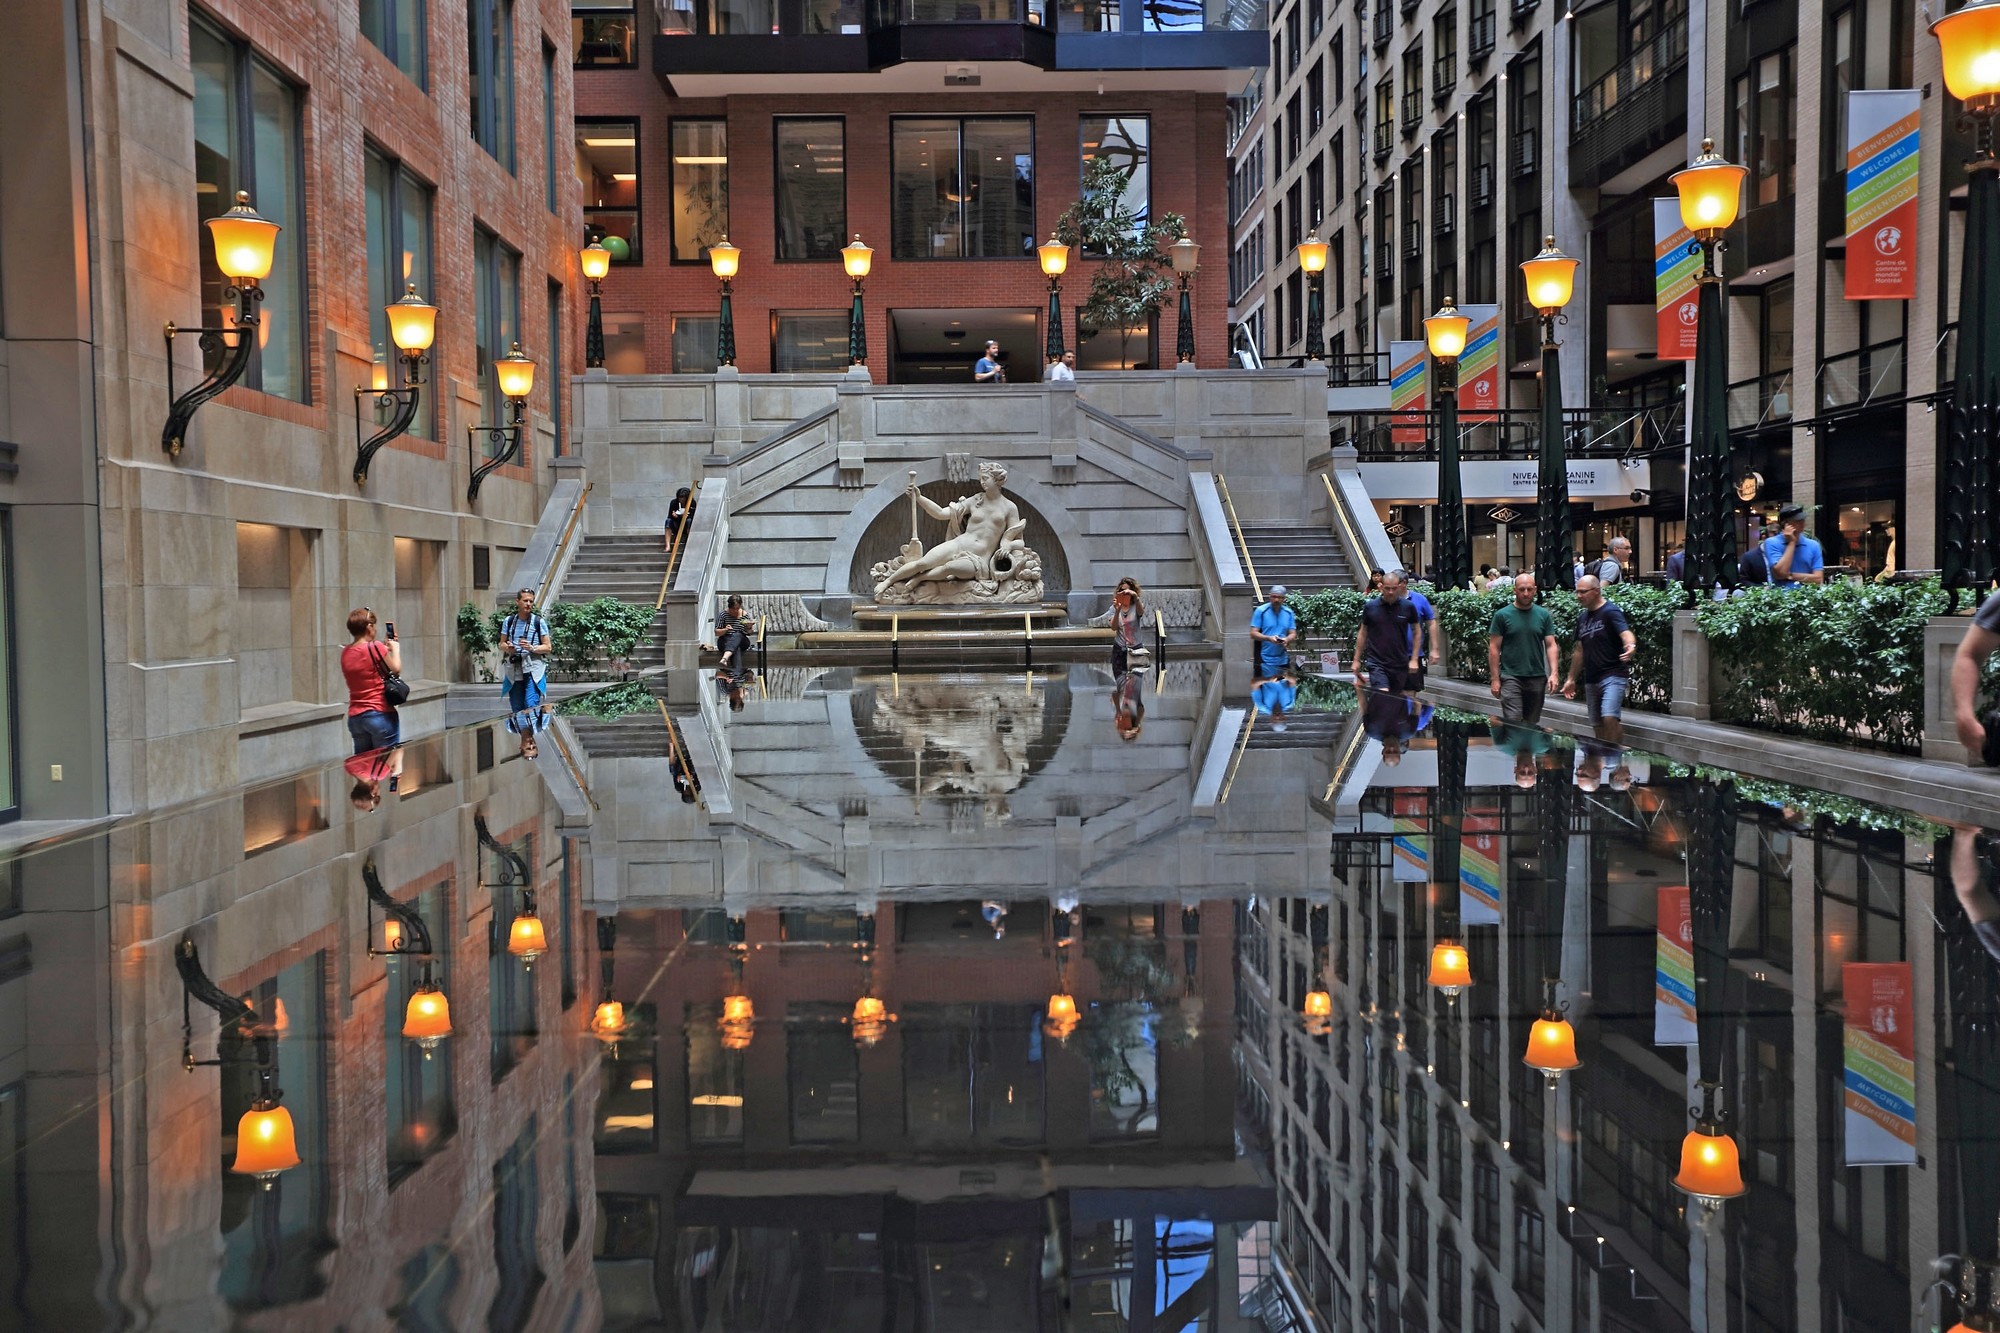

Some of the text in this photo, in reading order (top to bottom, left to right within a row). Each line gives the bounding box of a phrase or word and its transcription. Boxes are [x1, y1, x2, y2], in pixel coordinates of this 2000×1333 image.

[1857, 125, 1904, 158] BIENVENUE
[1860, 146, 1906, 177] WELCOME!
[1852, 163, 1912, 203] WILLKOMMEN!
[1661, 229, 1690, 250] BIENVEN
[1512, 471, 1595, 480] NIVEA ZANINE
